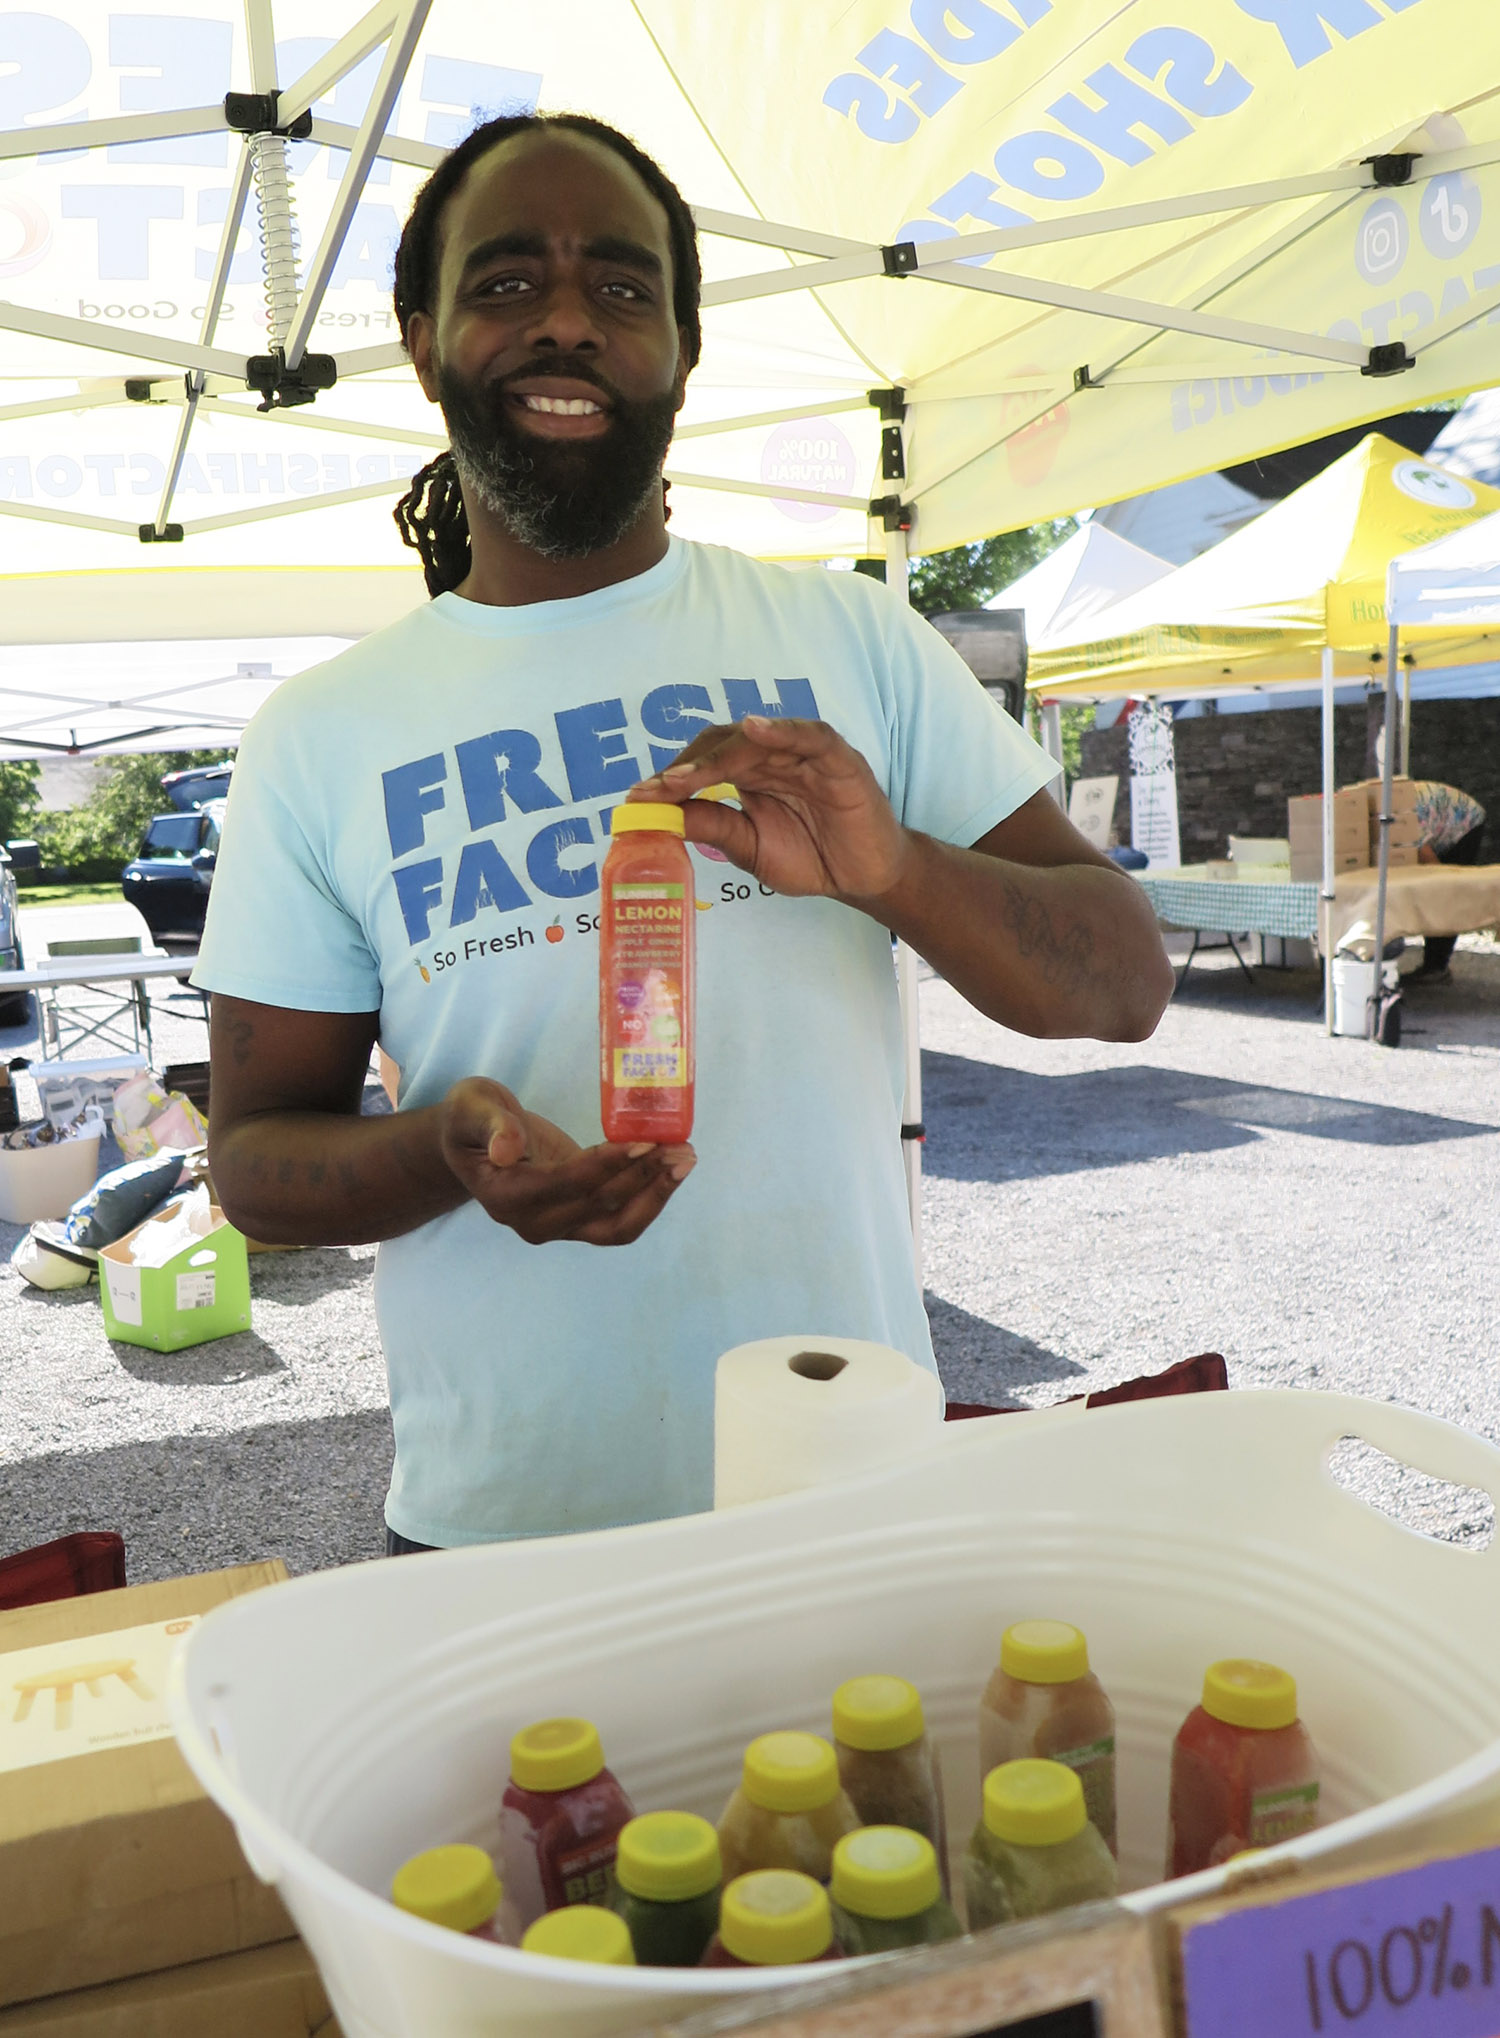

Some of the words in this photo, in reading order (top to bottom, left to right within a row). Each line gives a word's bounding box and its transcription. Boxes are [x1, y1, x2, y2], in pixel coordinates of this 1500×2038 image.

[392, 809, 613, 946] FAC
[433, 951, 457, 972] So
[464, 926, 535, 960] Fresh
[721, 882, 751, 902] So
[615, 906, 682, 921] LEMON
[615, 924, 682, 935] NECTARINE
[622, 1053, 678, 1066] FRESH
[1304, 1902, 1471, 2033] 100%
